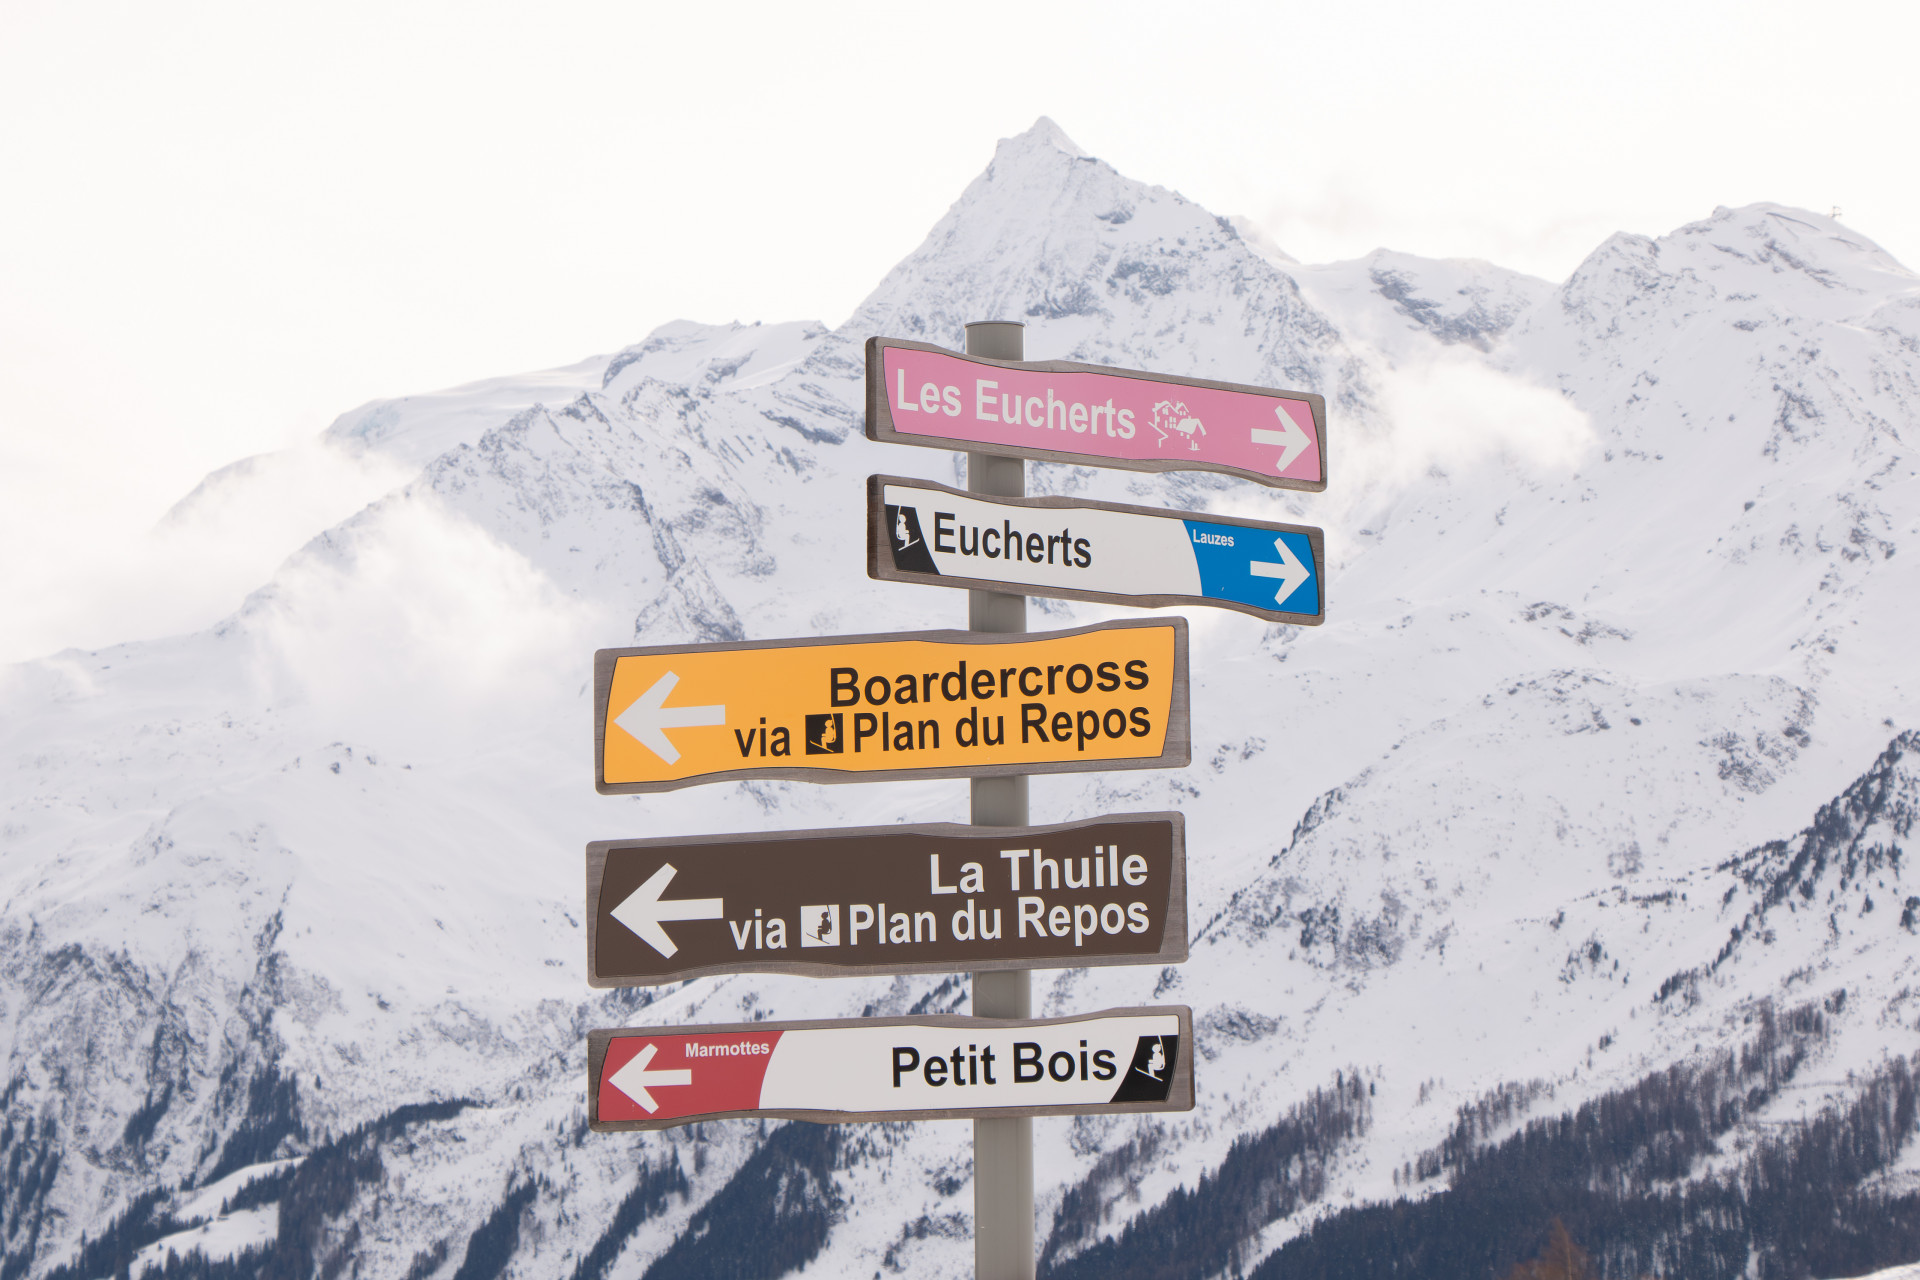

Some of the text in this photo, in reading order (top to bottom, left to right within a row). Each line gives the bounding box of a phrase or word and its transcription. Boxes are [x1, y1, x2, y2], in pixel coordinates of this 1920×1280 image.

[897, 369, 1136, 440] Les Eucherts
[934, 512, 1092, 568] Eucherts
[1193, 529, 1234, 547] Lauzes
[830, 659, 1149, 707] Boardercross
[734, 702, 1151, 757] via Plan du Repos
[930, 844, 1148, 894] La Thuile
[729, 895, 1149, 950] via Plan du Repos
[685, 1039, 770, 1058] Marmottes
[892, 1039, 1117, 1087] Petit Bois
